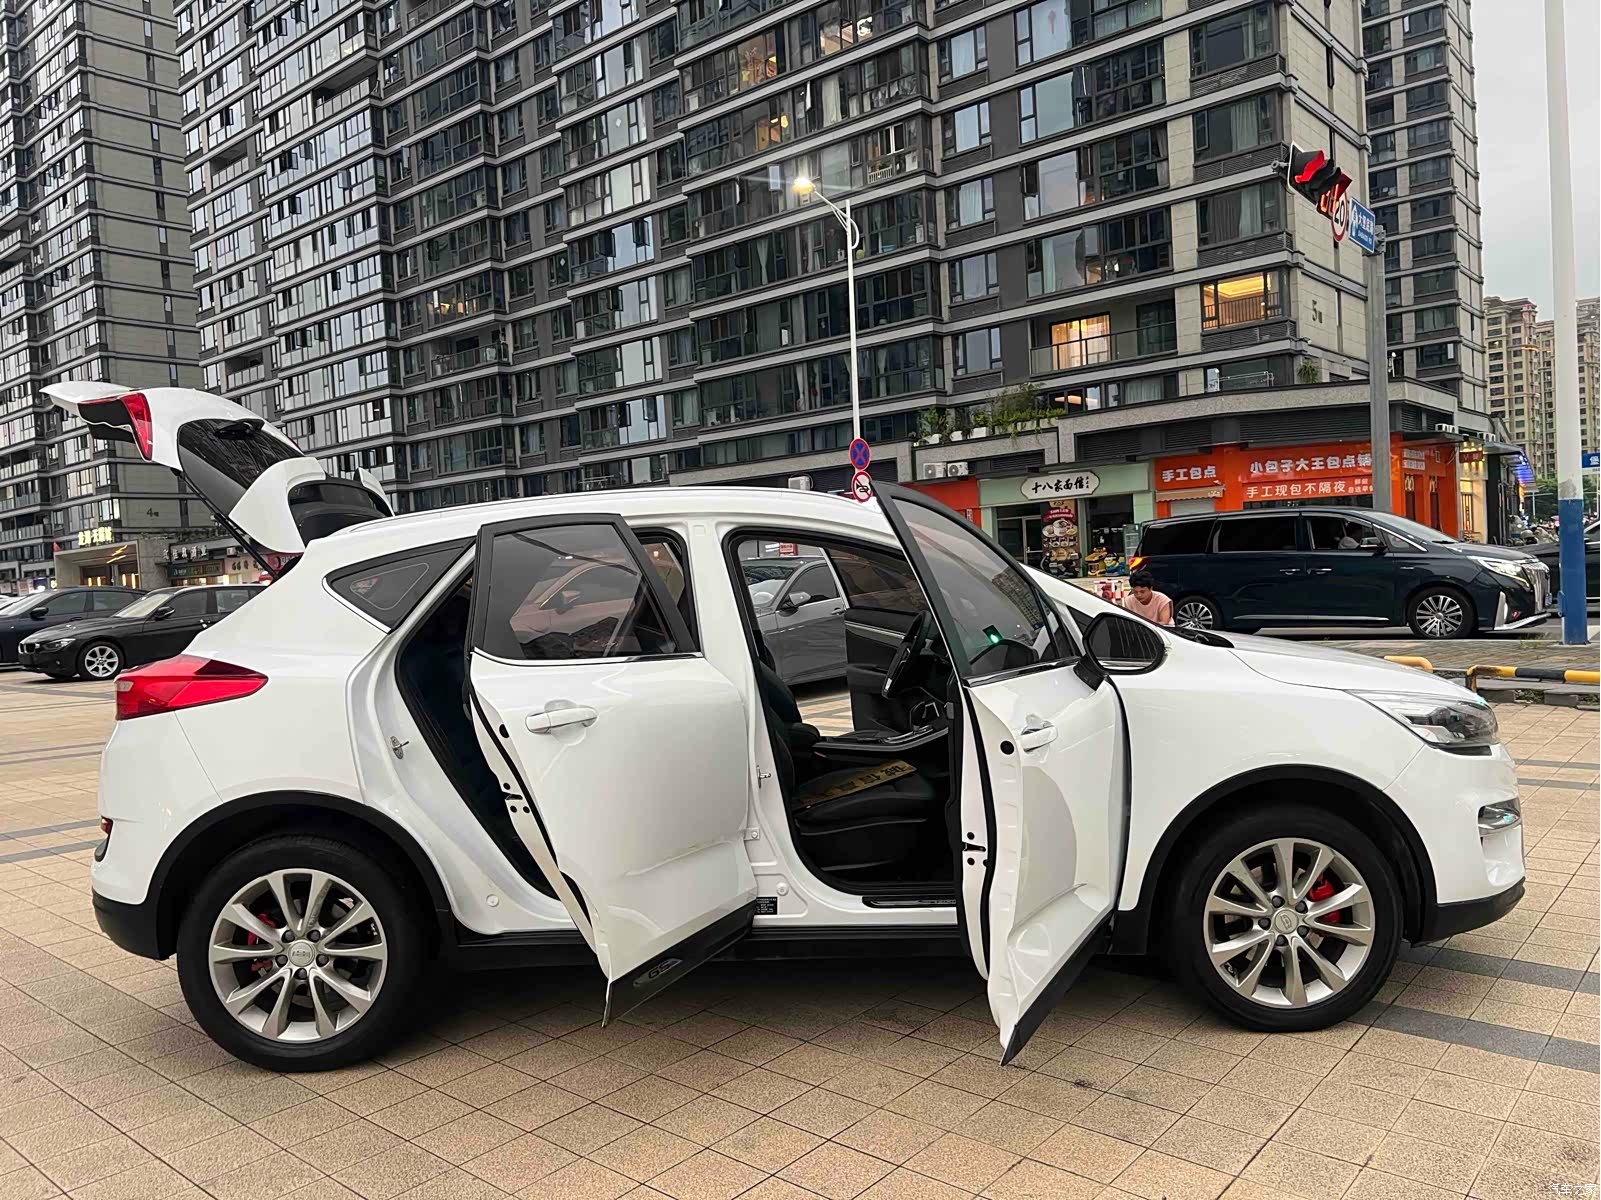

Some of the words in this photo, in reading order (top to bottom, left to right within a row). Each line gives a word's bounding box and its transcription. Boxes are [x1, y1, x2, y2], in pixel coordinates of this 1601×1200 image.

[1161, 465, 1217, 483] 手工包点
[1246, 481, 1347, 499] 手工现包不隔夜
